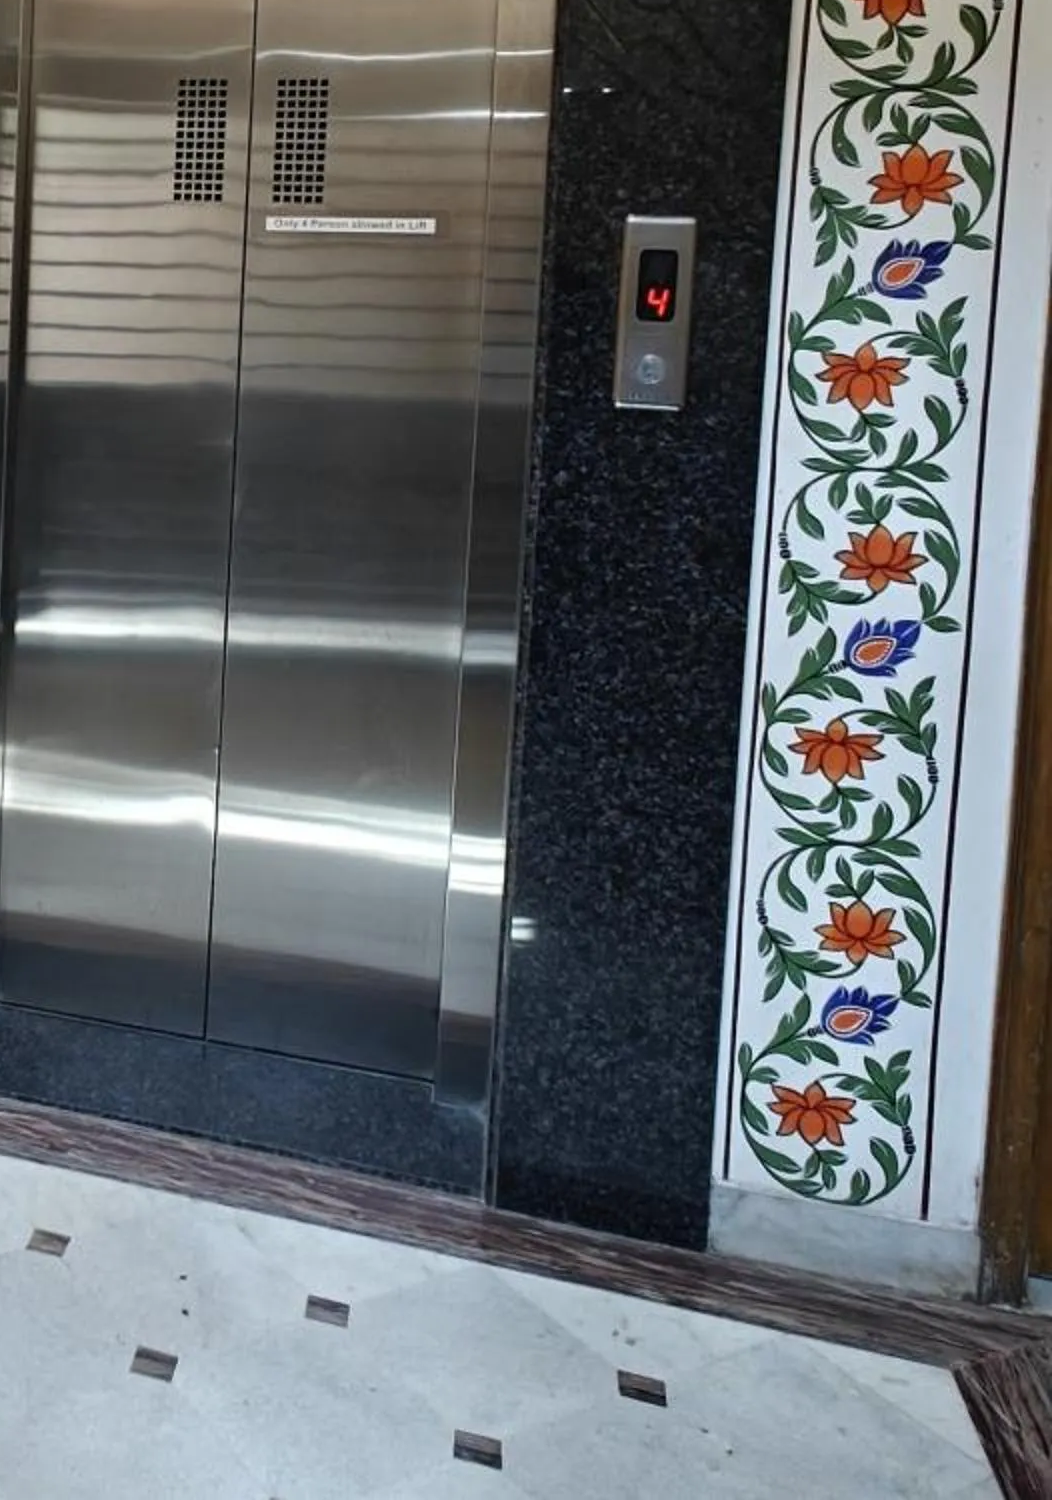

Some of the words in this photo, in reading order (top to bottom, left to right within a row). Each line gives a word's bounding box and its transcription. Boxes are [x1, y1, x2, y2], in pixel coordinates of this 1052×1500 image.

[273, 219, 297, 229] Only
[301, 220, 308, 228] 4
[311, 219, 348, 229] Person
[352, 219, 392, 230] allowed
[395, 221, 405, 229] in
[408, 221, 427, 230] Lift
[647, 288, 669, 317] 4
